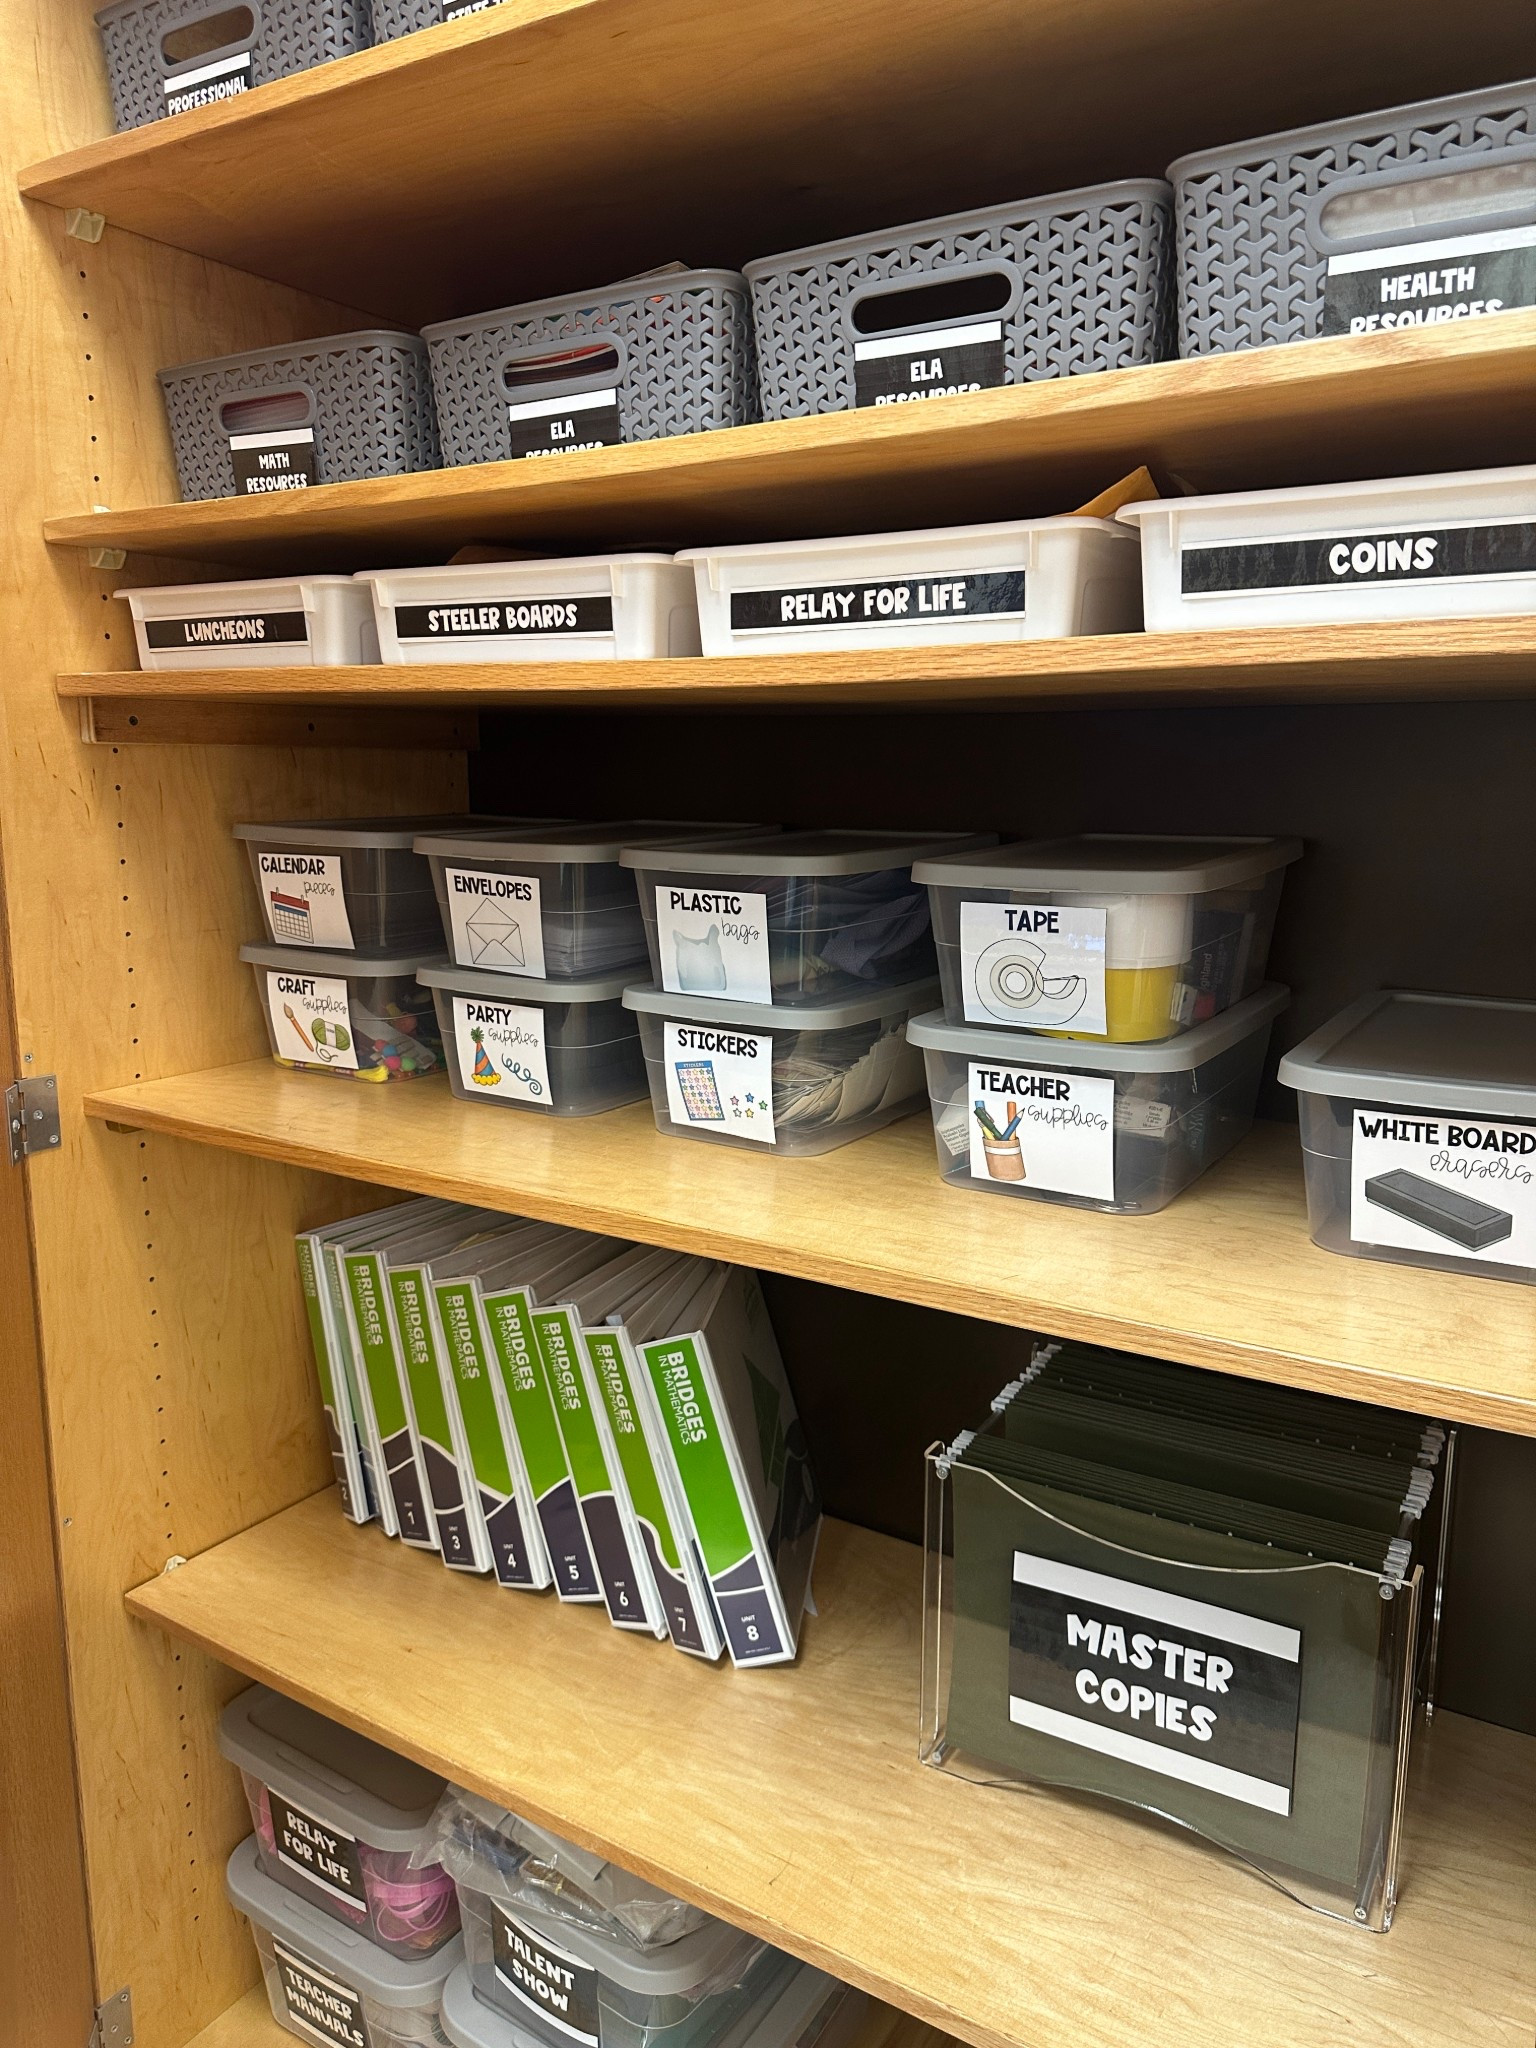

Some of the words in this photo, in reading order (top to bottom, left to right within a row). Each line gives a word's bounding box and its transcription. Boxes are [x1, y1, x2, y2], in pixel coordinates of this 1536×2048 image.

[168, 75, 248, 116] PROFESSIONAL
[1380, 266, 1476, 302] HEALTH
[1350, 298, 1504, 334] RESOURCES
[910, 358, 943, 382] ELA
[550, 420, 575, 440] ELA
[258, 453, 290, 469] MATH
[246, 473, 307, 493] RESOURCES
[1329, 537, 1438, 576] COINS
[780, 592, 856, 622] RELAY
[864, 586, 910, 616] FOR
[918, 582, 966, 612] LIFE
[184, 618, 265, 642] LUNCHEONS
[428, 607, 500, 632] STEELER
[505, 603, 578, 630] BOARDS
[261, 856, 325, 876] CALENDAR
[304, 881, 335, 898] pieces
[454, 875, 532, 901] ENVELOPES
[670, 890, 742, 915] PLASTIC
[720, 917, 760, 944] bags
[1004, 910, 1060, 934] TAPE
[278, 977, 316, 996] CRAFT
[302, 996, 347, 1014] supplies
[466, 1004, 512, 1026] PARTY
[488, 1026, 538, 1048] supplies
[678, 1028, 758, 1058] STICKERS
[977, 1070, 1070, 1101] TEACHER
[1028, 1104, 1109, 1130] supplies
[1358, 1116, 1439, 1145] WHITE
[1448, 1125, 1536, 1154] BOARD
[1430, 1150, 1534, 1184] erasers
[398, 1282, 405, 1292] IN
[445, 1296, 453, 1307] IN
[353, 1266, 360, 1276] IN
[357, 1280, 374, 1346] MATHEMATICS
[360, 1265, 384, 1346] BRIDGES
[496, 1306, 504, 1318] IN
[401, 1296, 419, 1364] MATHEMATICS
[404, 1280, 428, 1364] BRIDGES
[452, 1294, 480, 1379] BRIDGES
[542, 1324, 550, 1334] IN
[448, 1310, 468, 1380] MATHEMATICS
[499, 1321, 522, 1392] MATHEMATICS
[503, 1304, 536, 1390] BRIDGES
[545, 1338, 570, 1410] MATHEMATICS
[548, 1322, 582, 1410] BRIDGES
[658, 1355, 668, 1368] IN
[595, 1345, 603, 1356] IN
[599, 1360, 625, 1433] MATHEMATICS
[601, 1344, 636, 1434] BRIDGES
[667, 1351, 707, 1442] BRIDGES
[662, 1370, 692, 1445] MATHEMATICS
[408, 1511, 414, 1525] 1
[452, 1535, 460, 1550] 3
[508, 1553, 516, 1568] 4
[568, 1565, 580, 1580] 5
[620, 1591, 628, 1606] 6
[678, 1616, 686, 1632] 7
[741, 1614, 755, 1622] UNIT
[746, 1625, 760, 1642] 8
[1066, 1614, 1234, 1694] MASTER
[1076, 1668, 1218, 1742] COPIES
[286, 1810, 337, 1854] RELAY
[284, 1830, 312, 1862] FOR
[317, 1852, 351, 1886] LIFE
[504, 1924, 575, 1990] TALENT
[286, 1966, 352, 2020] TEACHER
[512, 1958, 568, 2012] SHOW
[286, 1986, 364, 2046] MANUALS
